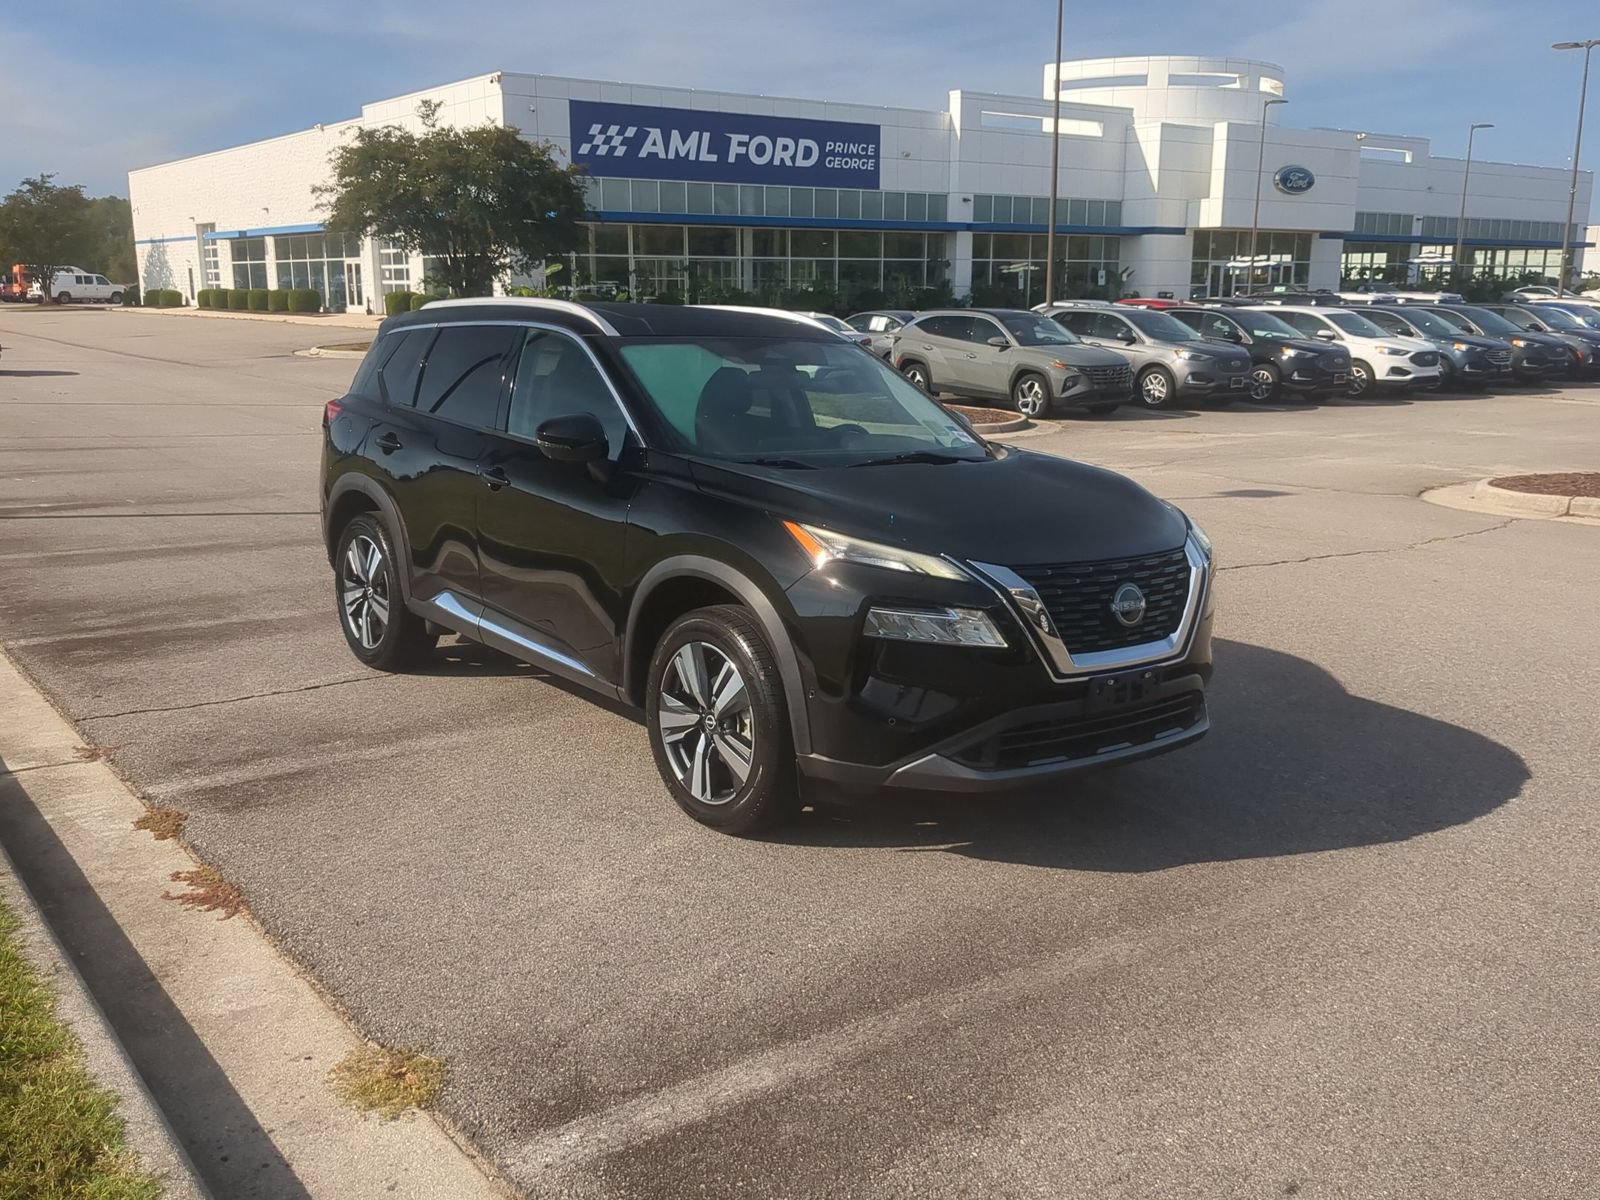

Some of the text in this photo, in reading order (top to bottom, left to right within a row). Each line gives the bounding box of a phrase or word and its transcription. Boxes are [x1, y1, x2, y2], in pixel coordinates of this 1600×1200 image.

[638, 127, 819, 167] AML FORD
[825, 141, 876, 155] PRINCE
[825, 156, 876, 170] GEORGE
